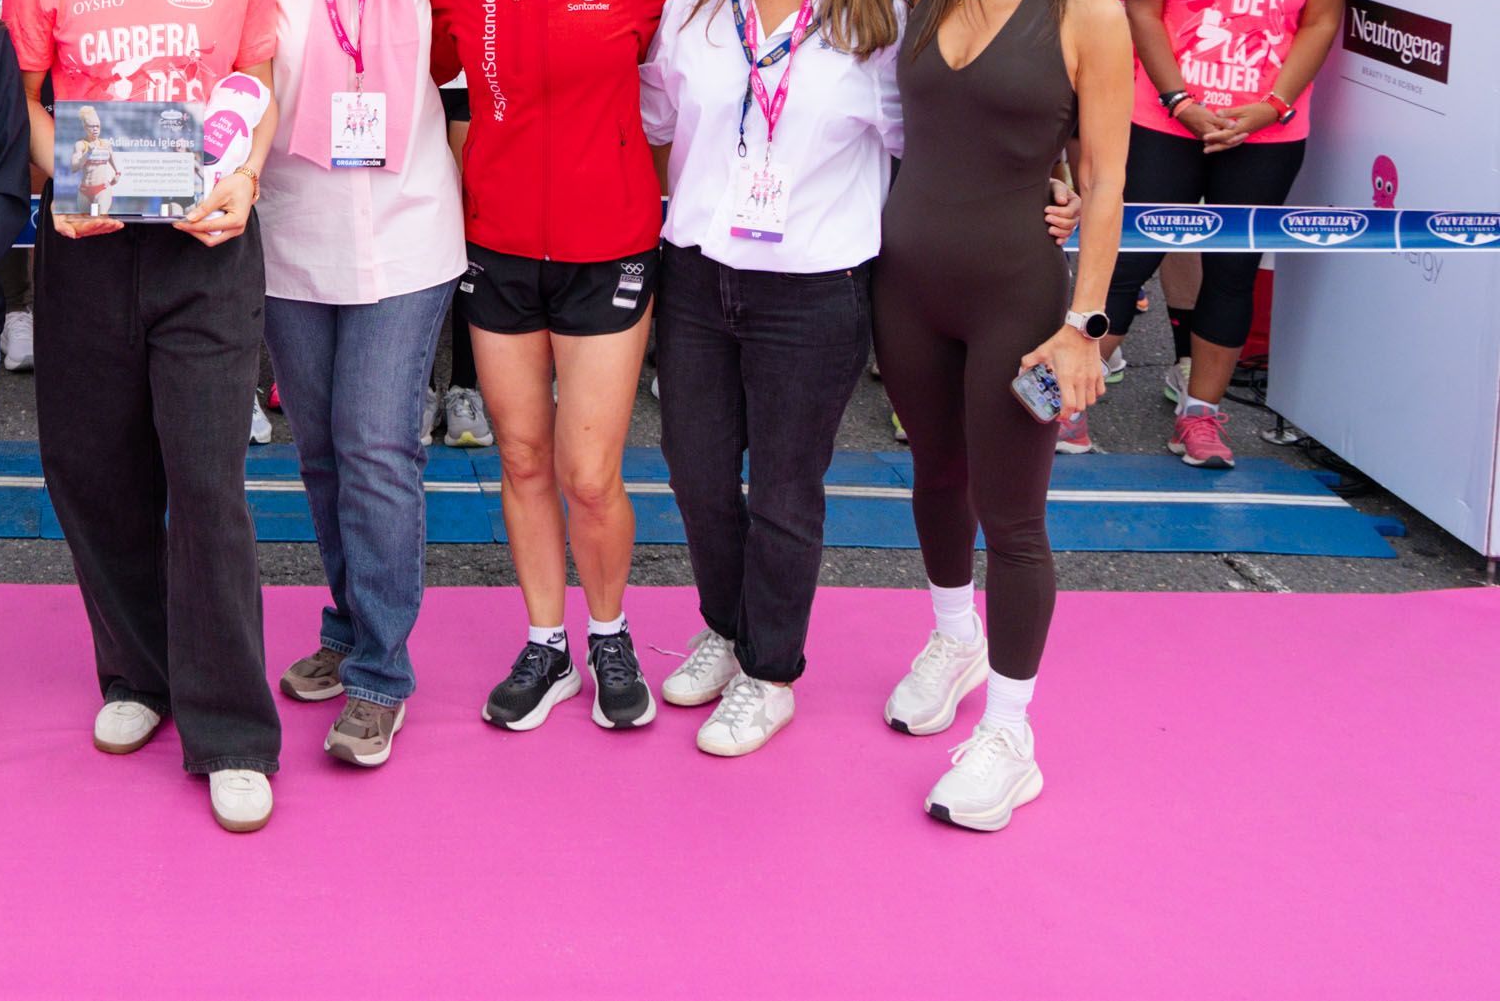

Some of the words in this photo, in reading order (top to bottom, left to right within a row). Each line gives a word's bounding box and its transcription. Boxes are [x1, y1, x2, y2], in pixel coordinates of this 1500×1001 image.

[567, 2, 610, 11] Santander
[1351, 7, 1442, 64] Neutrogena
[1181, 61, 1260, 93] MUJER
[1203, 90, 1232, 107] 2026
[109, 137, 156, 148] Adiaratou
[158, 137, 195, 150] Iglesias
[336, 158, 381, 167] ORGANIZACIÓN
